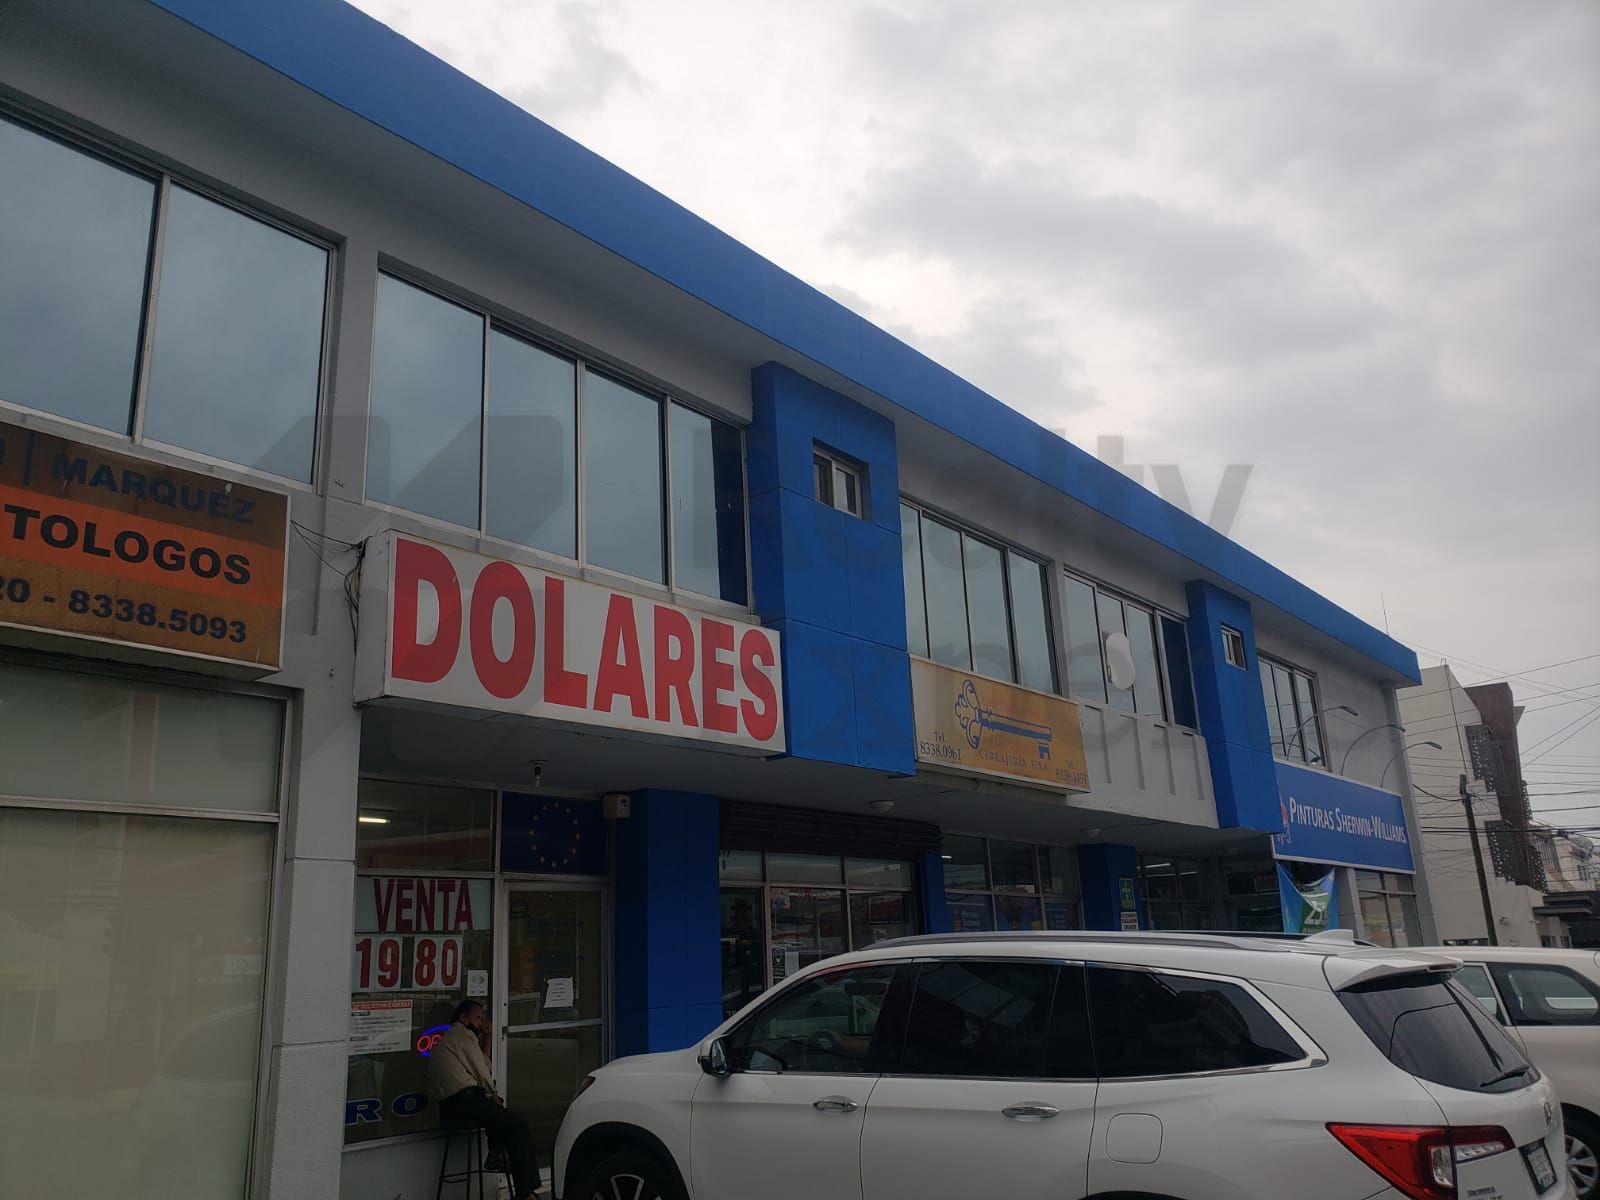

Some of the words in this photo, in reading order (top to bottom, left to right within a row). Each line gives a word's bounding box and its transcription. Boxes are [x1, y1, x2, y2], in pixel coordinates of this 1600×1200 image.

[52, 452, 257, 524] MARQUEZ
[4, 504, 251, 585] TOLOGOS
[68, 589, 247, 643] 8338.5093
[391, 537, 778, 741] DOLARES
[920, 740, 961, 761] 8338.0961
[373, 877, 473, 932] VENTA
